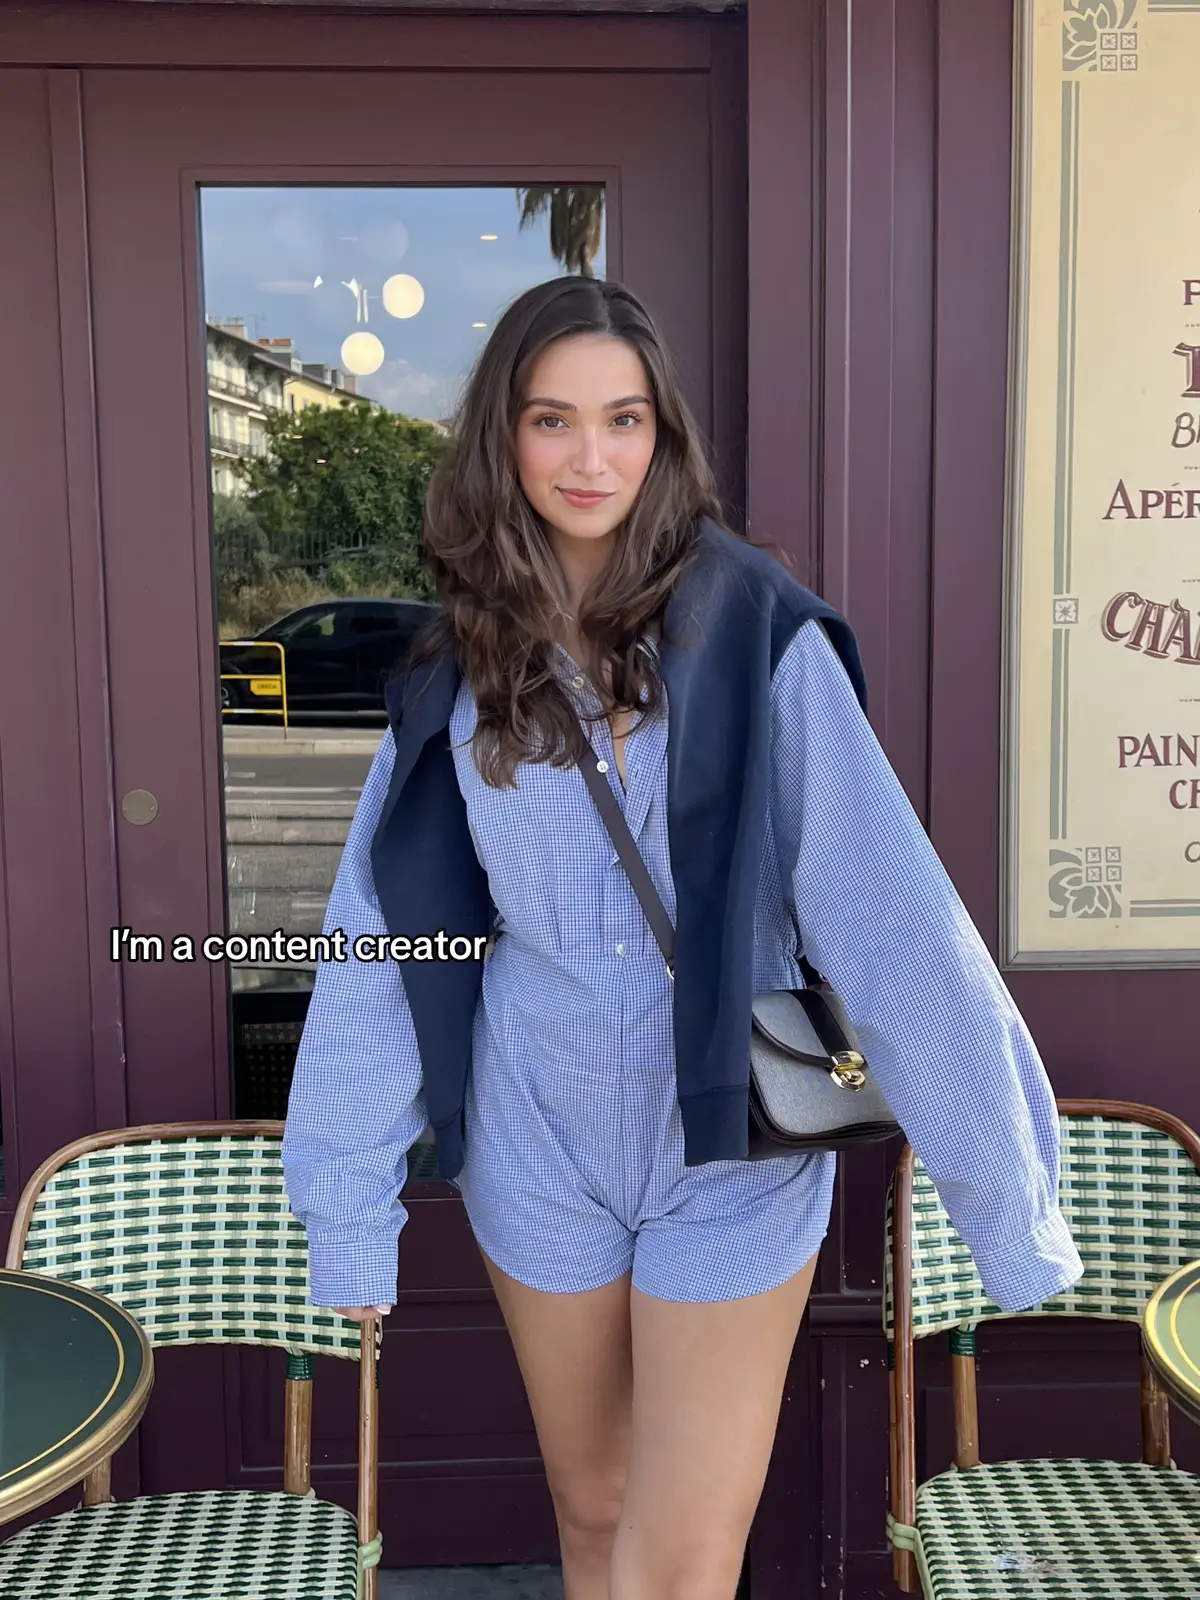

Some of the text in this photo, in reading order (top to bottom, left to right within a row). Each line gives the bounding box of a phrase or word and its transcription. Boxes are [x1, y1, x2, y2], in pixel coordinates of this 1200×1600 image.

[1171, 412, 1200, 448] B
[1100, 591, 1200, 665] CHA
[1117, 732, 1200, 768] PAIN
